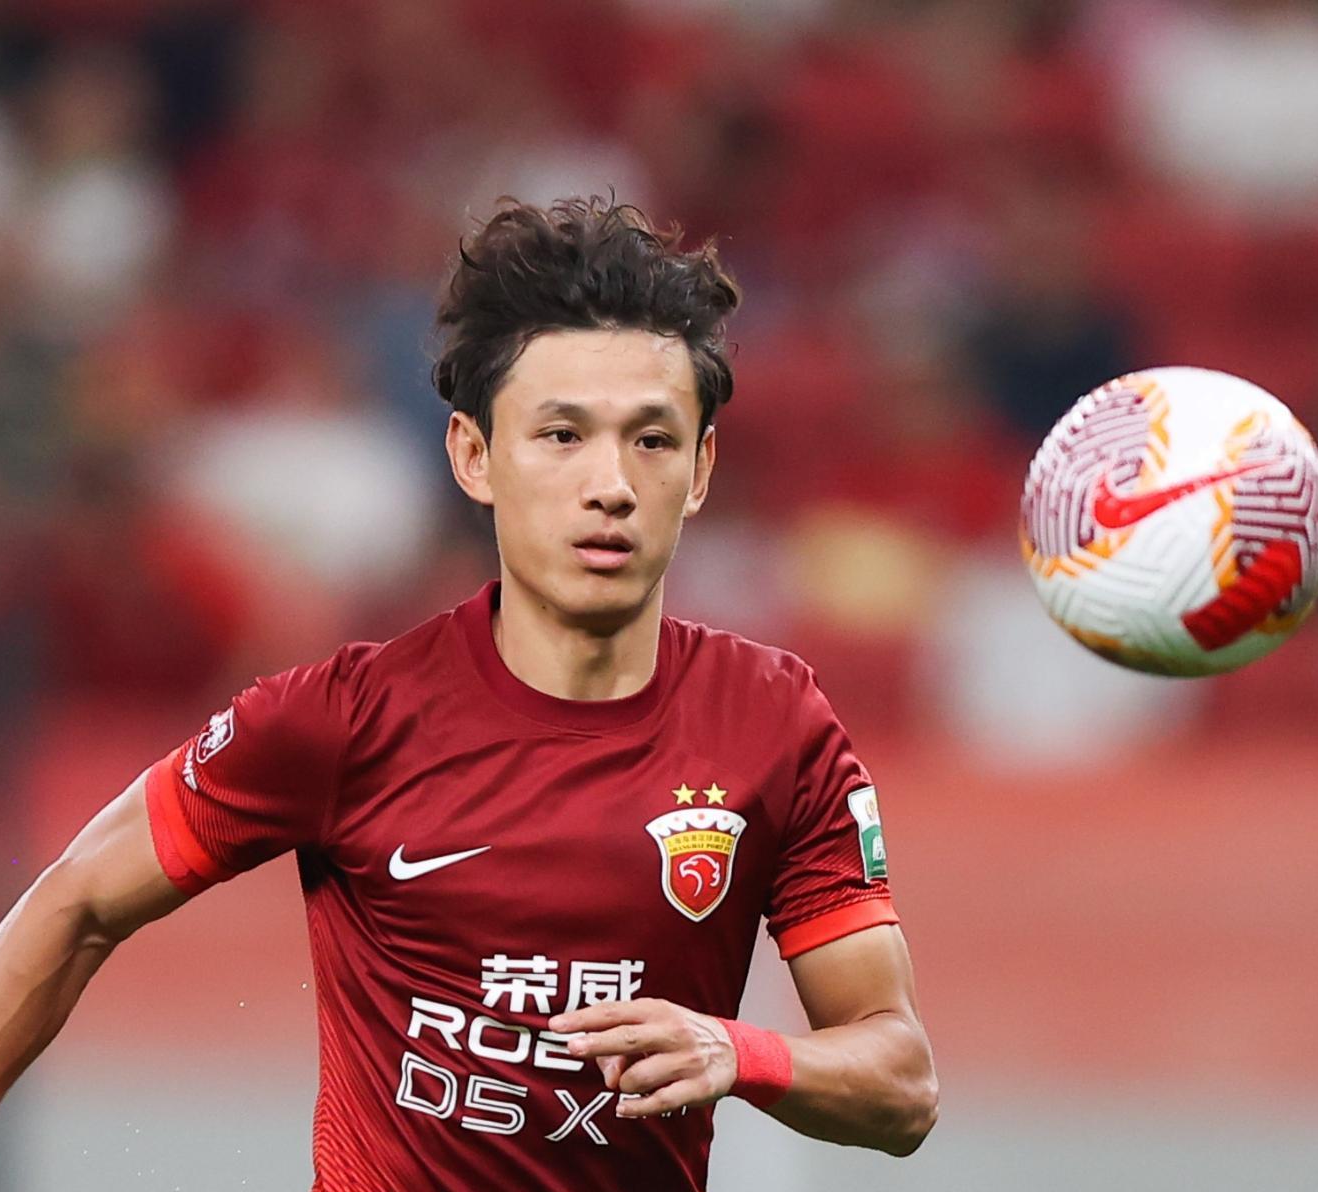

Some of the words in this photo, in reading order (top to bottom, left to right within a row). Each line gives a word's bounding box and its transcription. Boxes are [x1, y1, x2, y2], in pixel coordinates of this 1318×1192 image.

[480, 953, 646, 1014] 荣威
[406, 996, 585, 1072] ROE
[395, 1050, 529, 1136] D5
